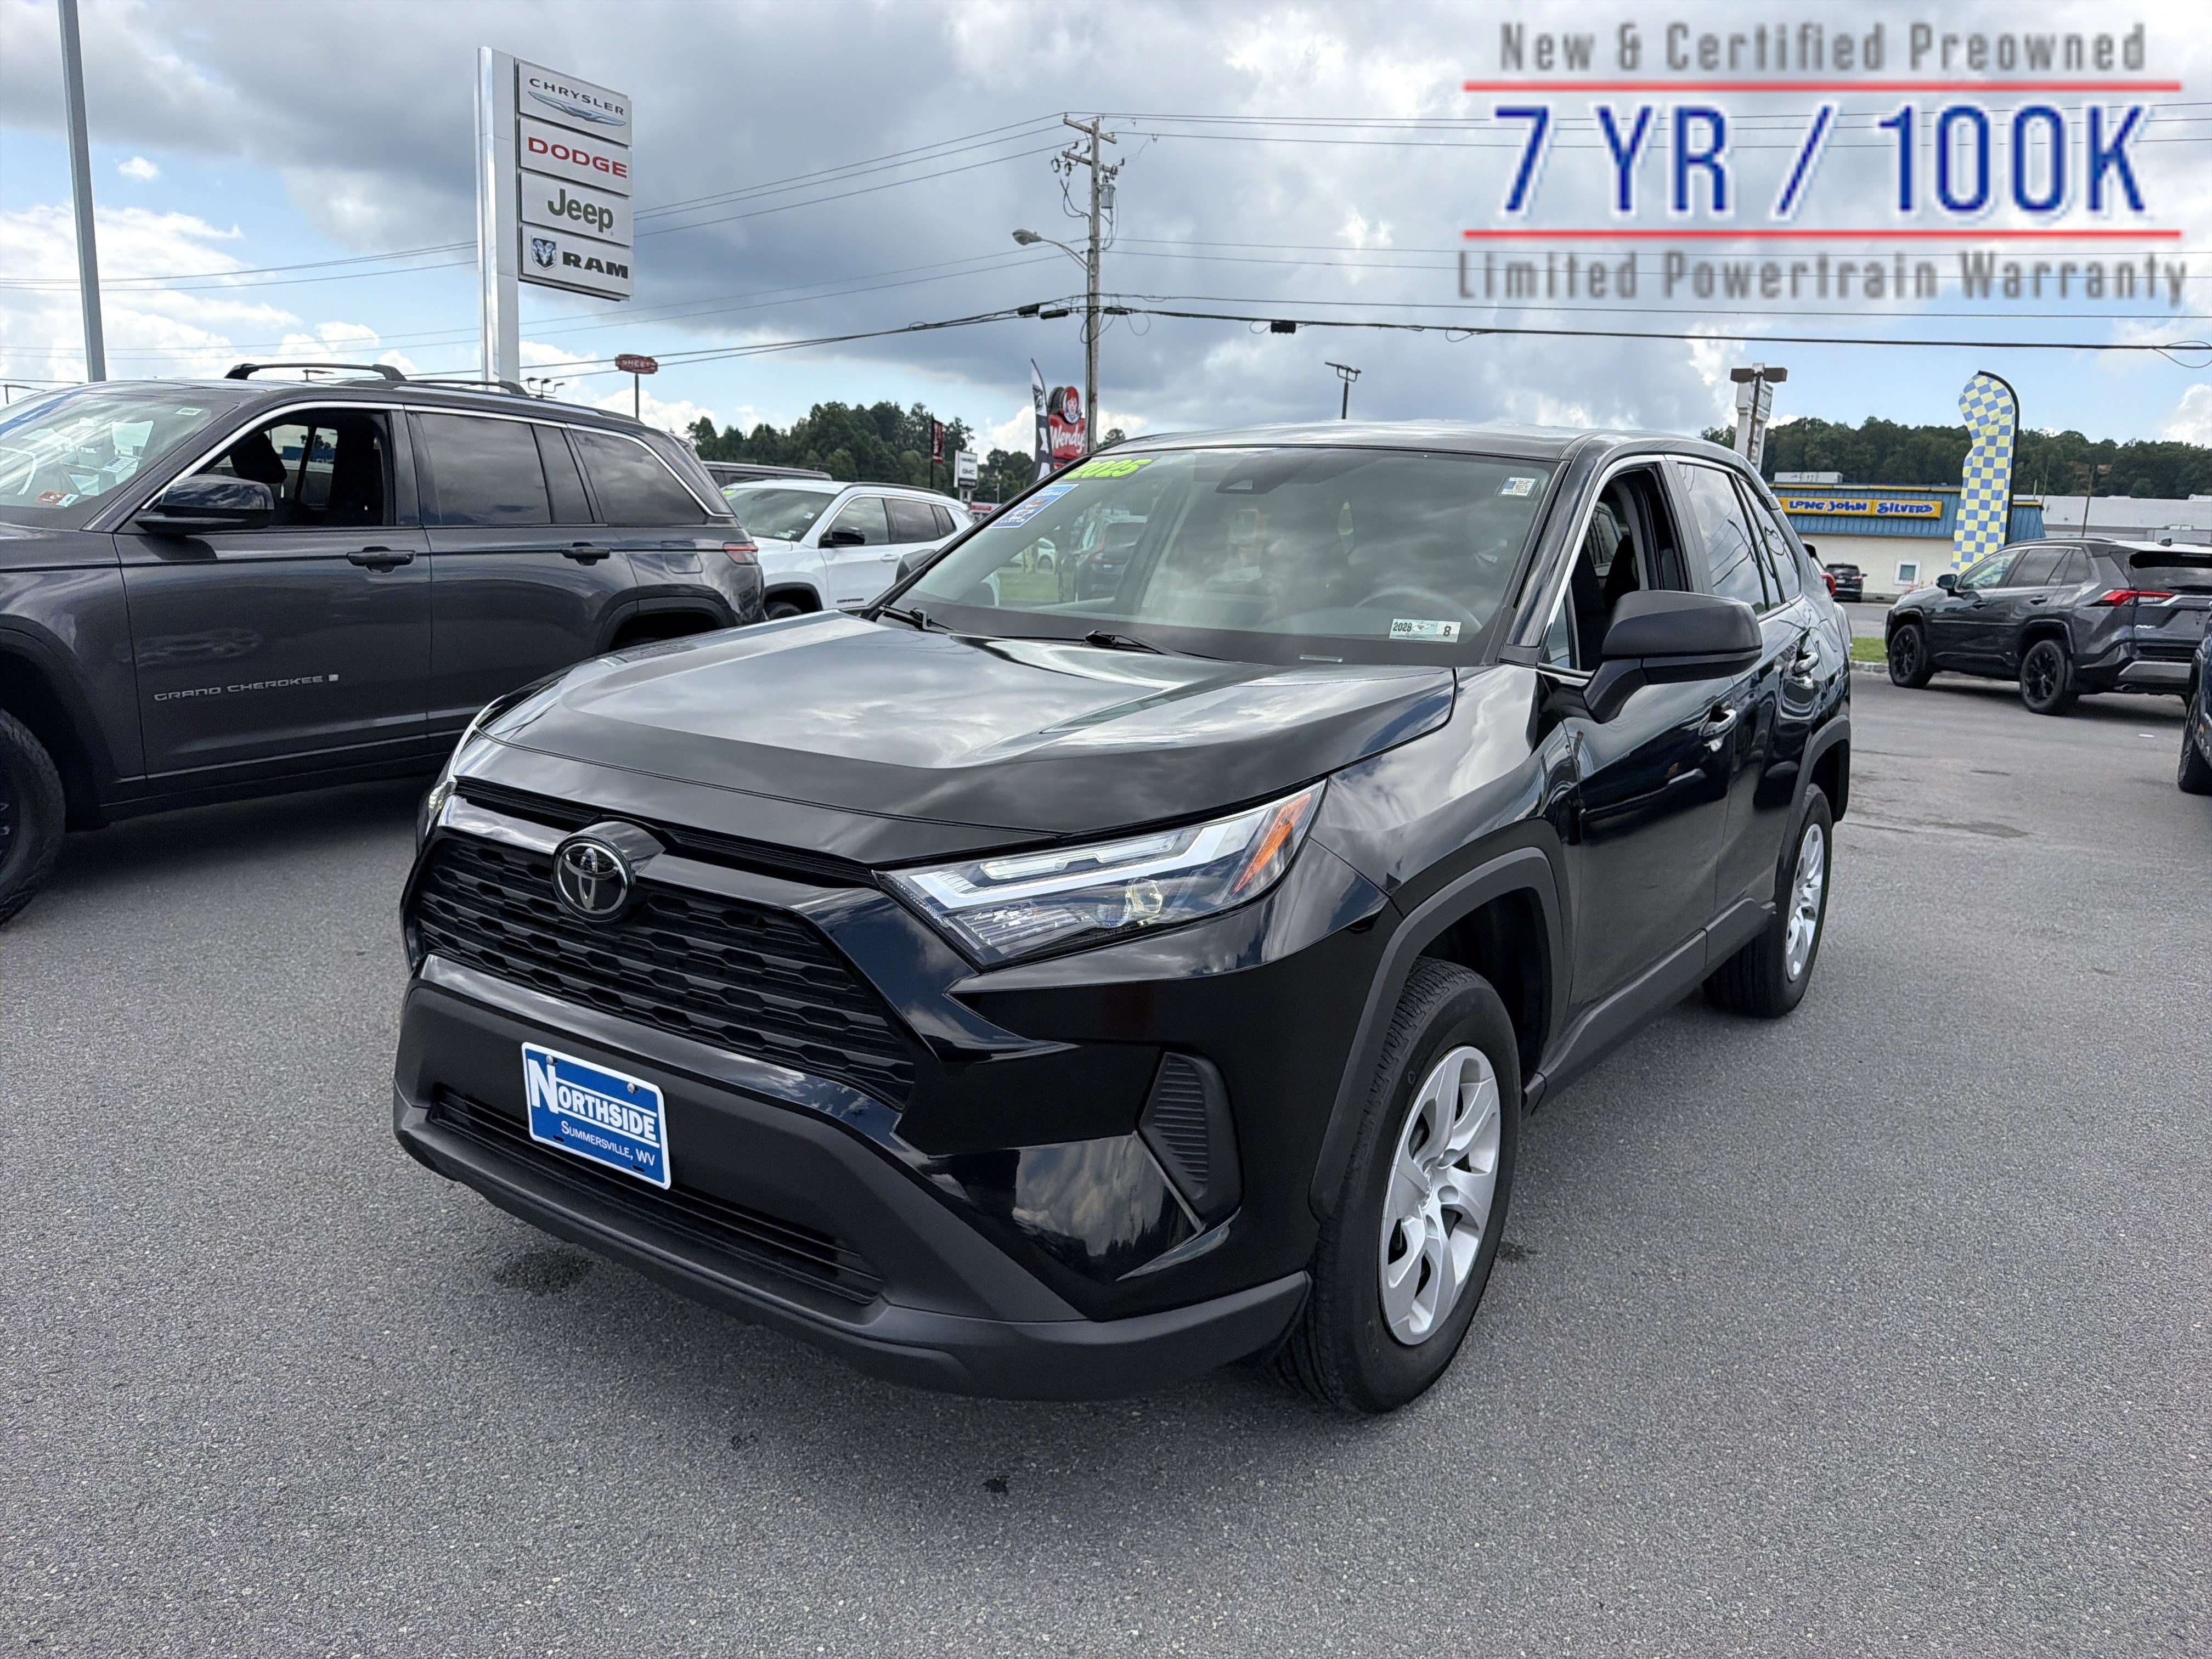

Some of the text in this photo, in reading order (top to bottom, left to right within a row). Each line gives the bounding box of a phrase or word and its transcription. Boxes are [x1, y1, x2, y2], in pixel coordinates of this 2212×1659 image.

[529, 78, 624, 116] CHRYSLER
[528, 136, 627, 179] DODGE
[548, 188, 613, 233] Jeep
[562, 251, 628, 279] RAM
[1064, 459, 1153, 479] 2025
[1788, 500, 1826, 510] LONG
[1392, 622, 1452, 637] 2028 8
[154, 675, 323, 701] GRAND CHEROKEE
[527, 1058, 657, 1141] NORTHSIDE
[561, 1120, 656, 1166] SUMMERSVILLE, WV
